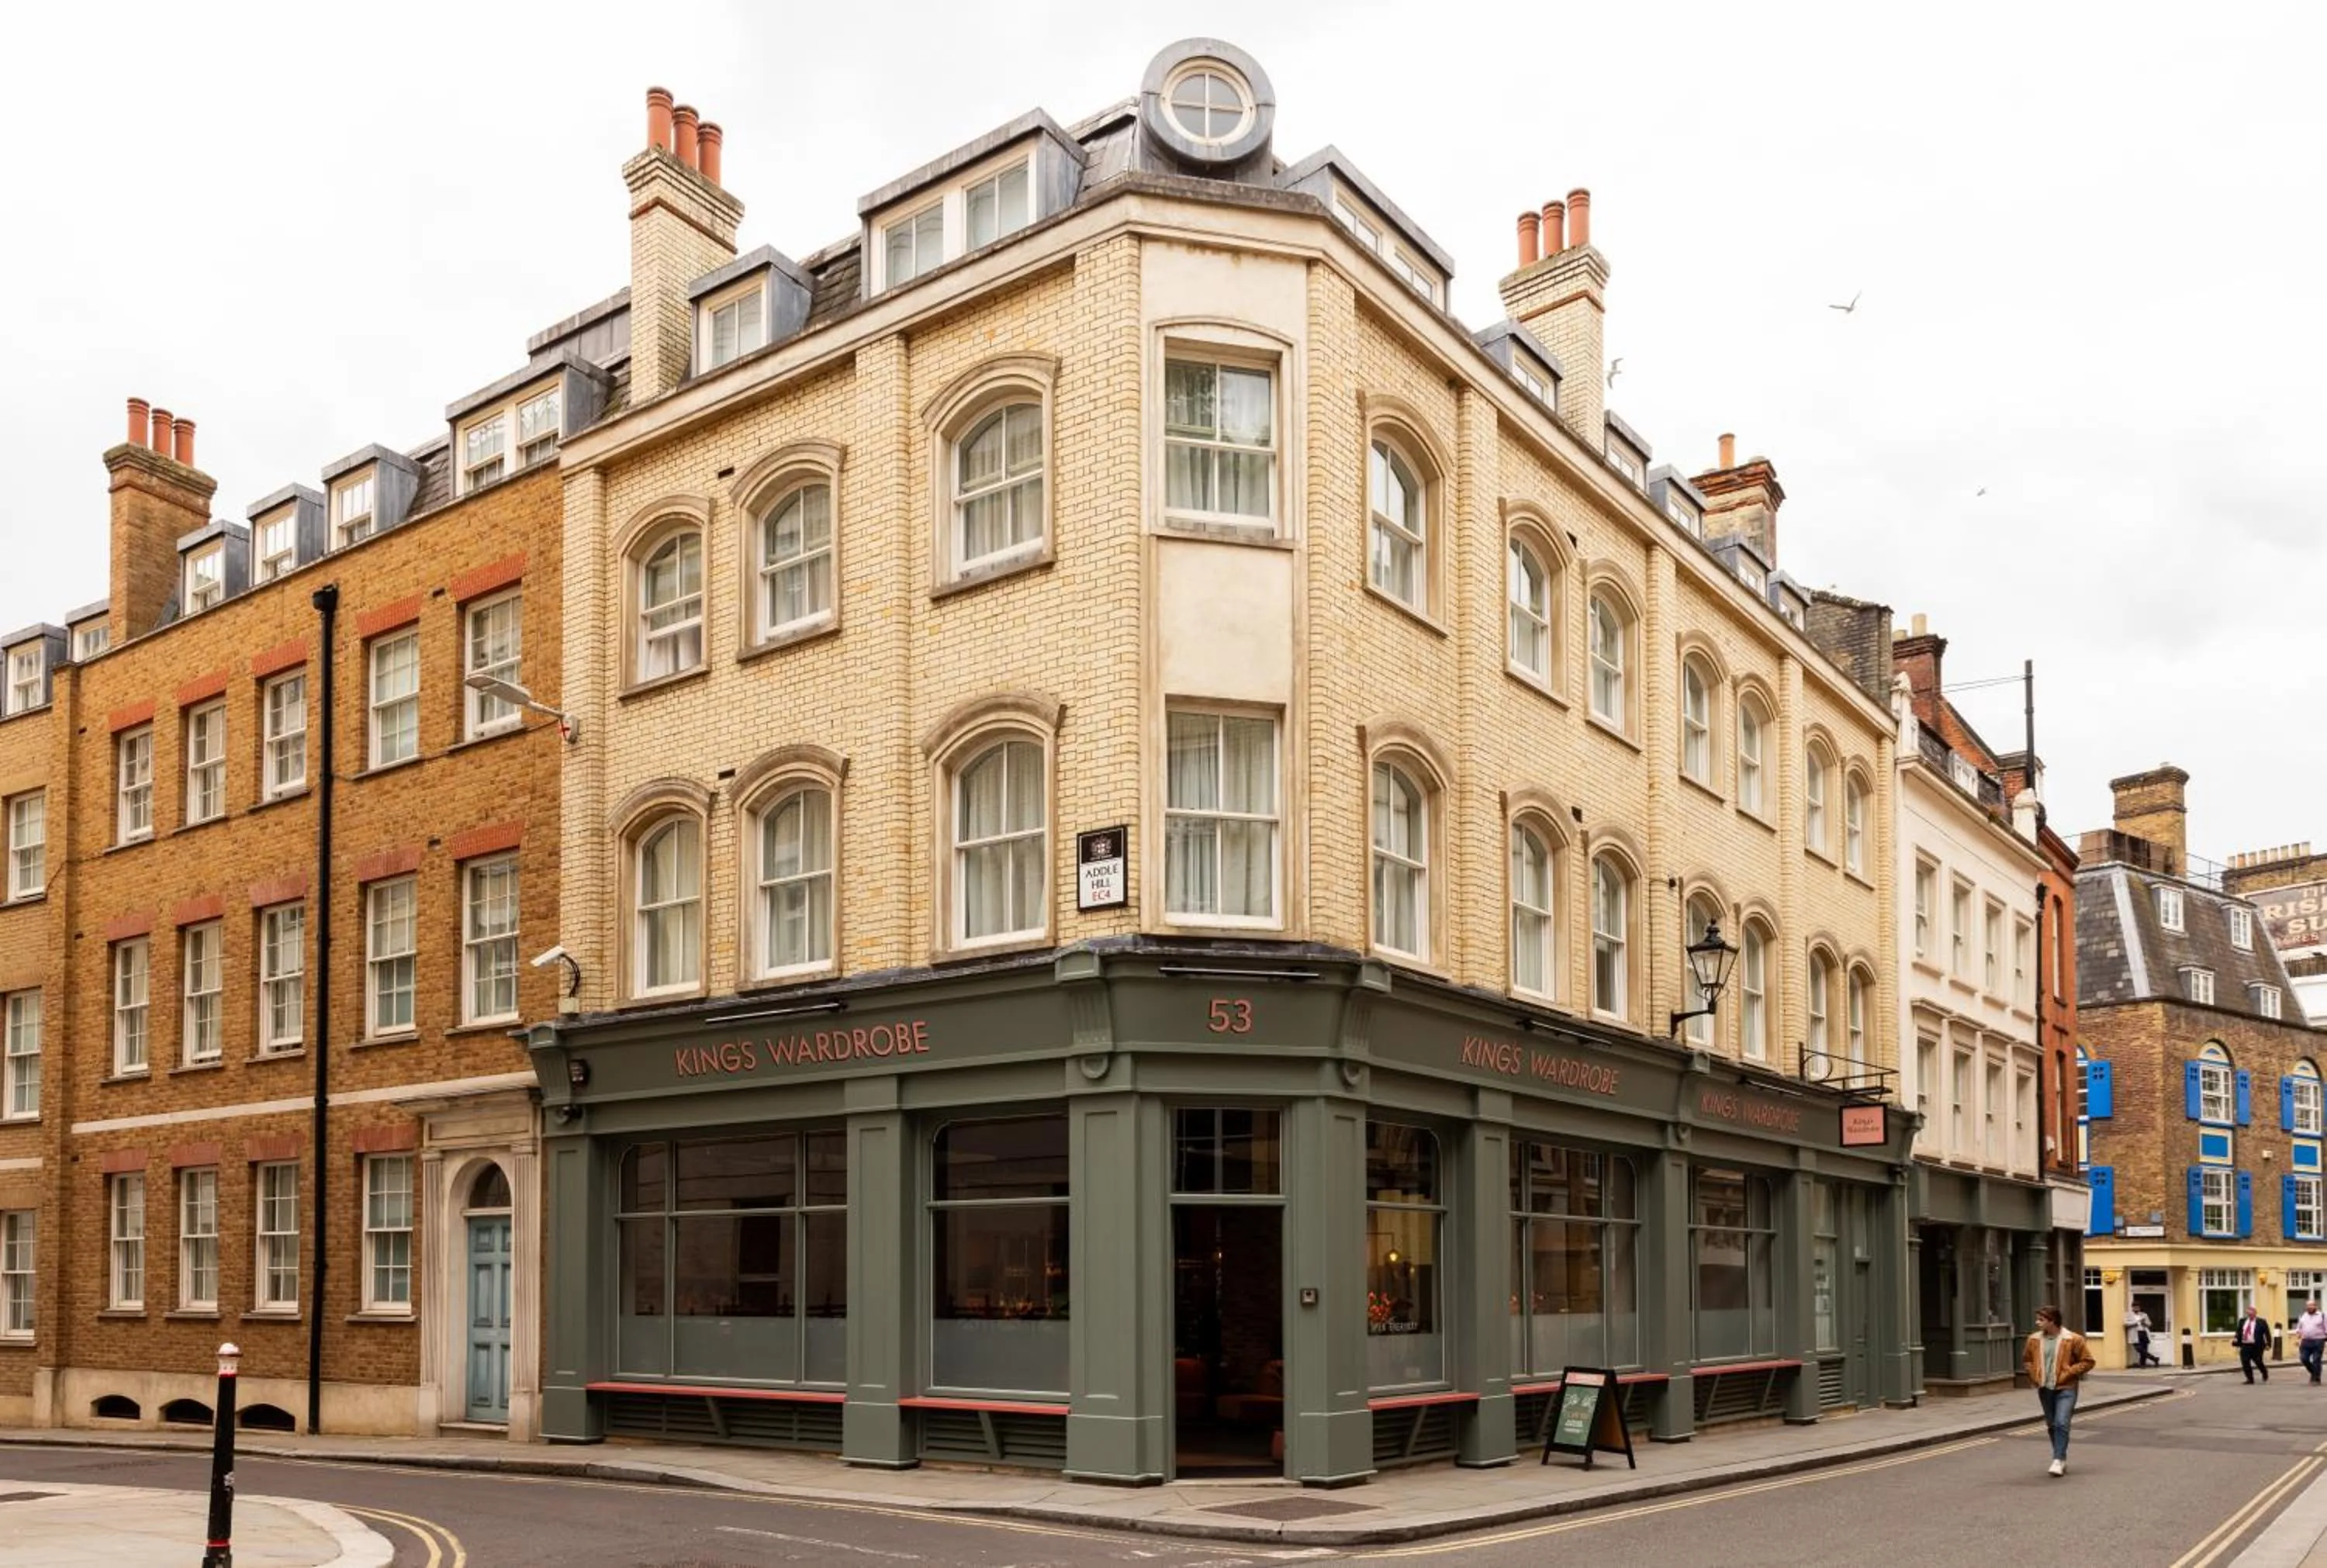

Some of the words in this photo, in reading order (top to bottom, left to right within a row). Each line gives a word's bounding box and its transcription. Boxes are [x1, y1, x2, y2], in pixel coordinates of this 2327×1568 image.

[1085, 863, 1118, 878] ADDLE
[1091, 879, 1111, 889] HILL
[1091, 889, 1111, 901] EC4
[2287, 916, 2327, 934] SU
[1208, 998, 1252, 1033] 53
[674, 1038, 757, 1078] KING'S
[766, 1021, 931, 1066] WARDROBE
[1461, 1035, 1523, 1075] KING'S
[1531, 1048, 1620, 1096] WARDROBE
[1743, 1100, 1801, 1132] WARDROBE
